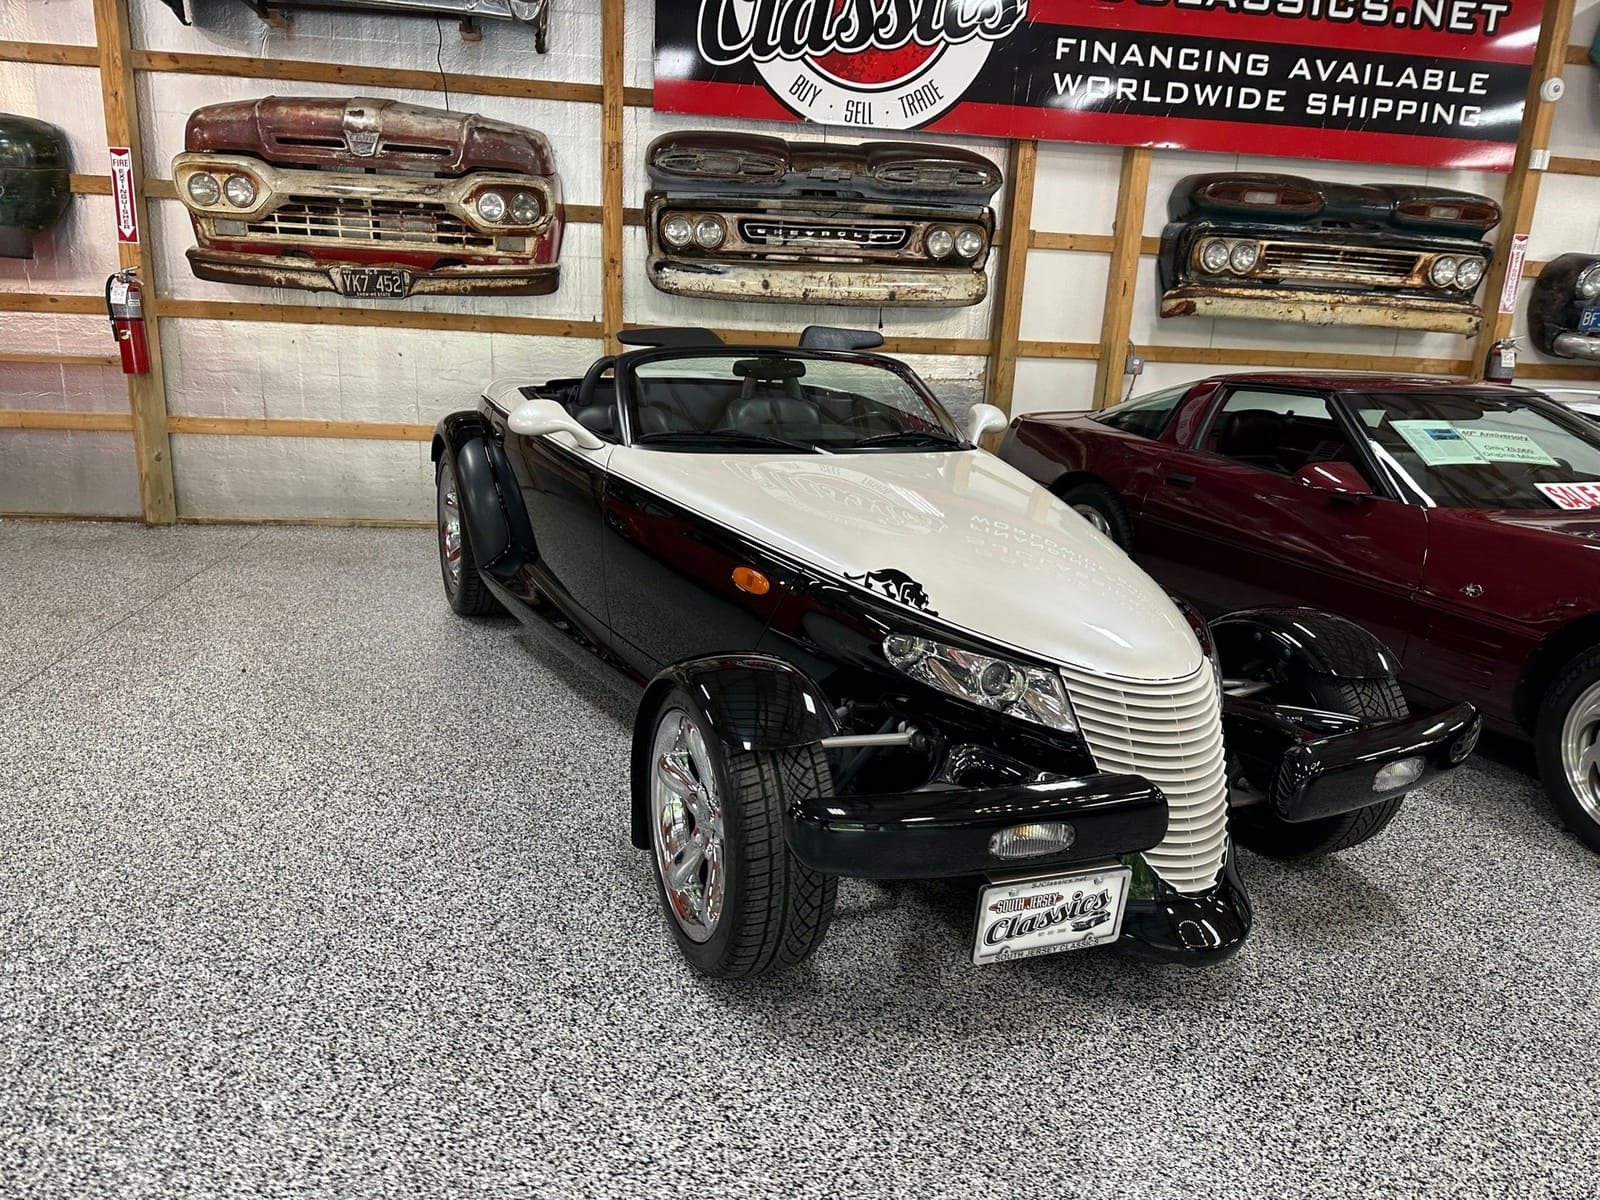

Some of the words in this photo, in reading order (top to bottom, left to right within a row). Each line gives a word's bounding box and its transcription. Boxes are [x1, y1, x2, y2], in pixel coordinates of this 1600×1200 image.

[1054, 37, 1270, 77] FINANCING
[1288, 57, 1490, 95] AVAILABLE
[788, 74, 822, 108] BUY
[844, 100, 874, 125] SELL
[897, 79, 944, 119] TRADE
[1053, 72, 1287, 113] WORLDWIDE
[1305, 93, 1482, 128] SHIPPING
[112, 159, 128, 167] FIRE
[118, 169, 130, 230] EXTINGUISHER
[344, 274, 368, 292] YK7
[376, 275, 402, 293] 452
[1582, 311, 1600, 326] BF
[1545, 486, 1600, 508] SALE
[995, 897, 1024, 914] SOUTH
[1026, 892, 1060, 910] JERSEY
[984, 889, 1112, 946] Classics
[994, 951, 1024, 962] SOUTH
[1026, 945, 1057, 958] JERSEY
